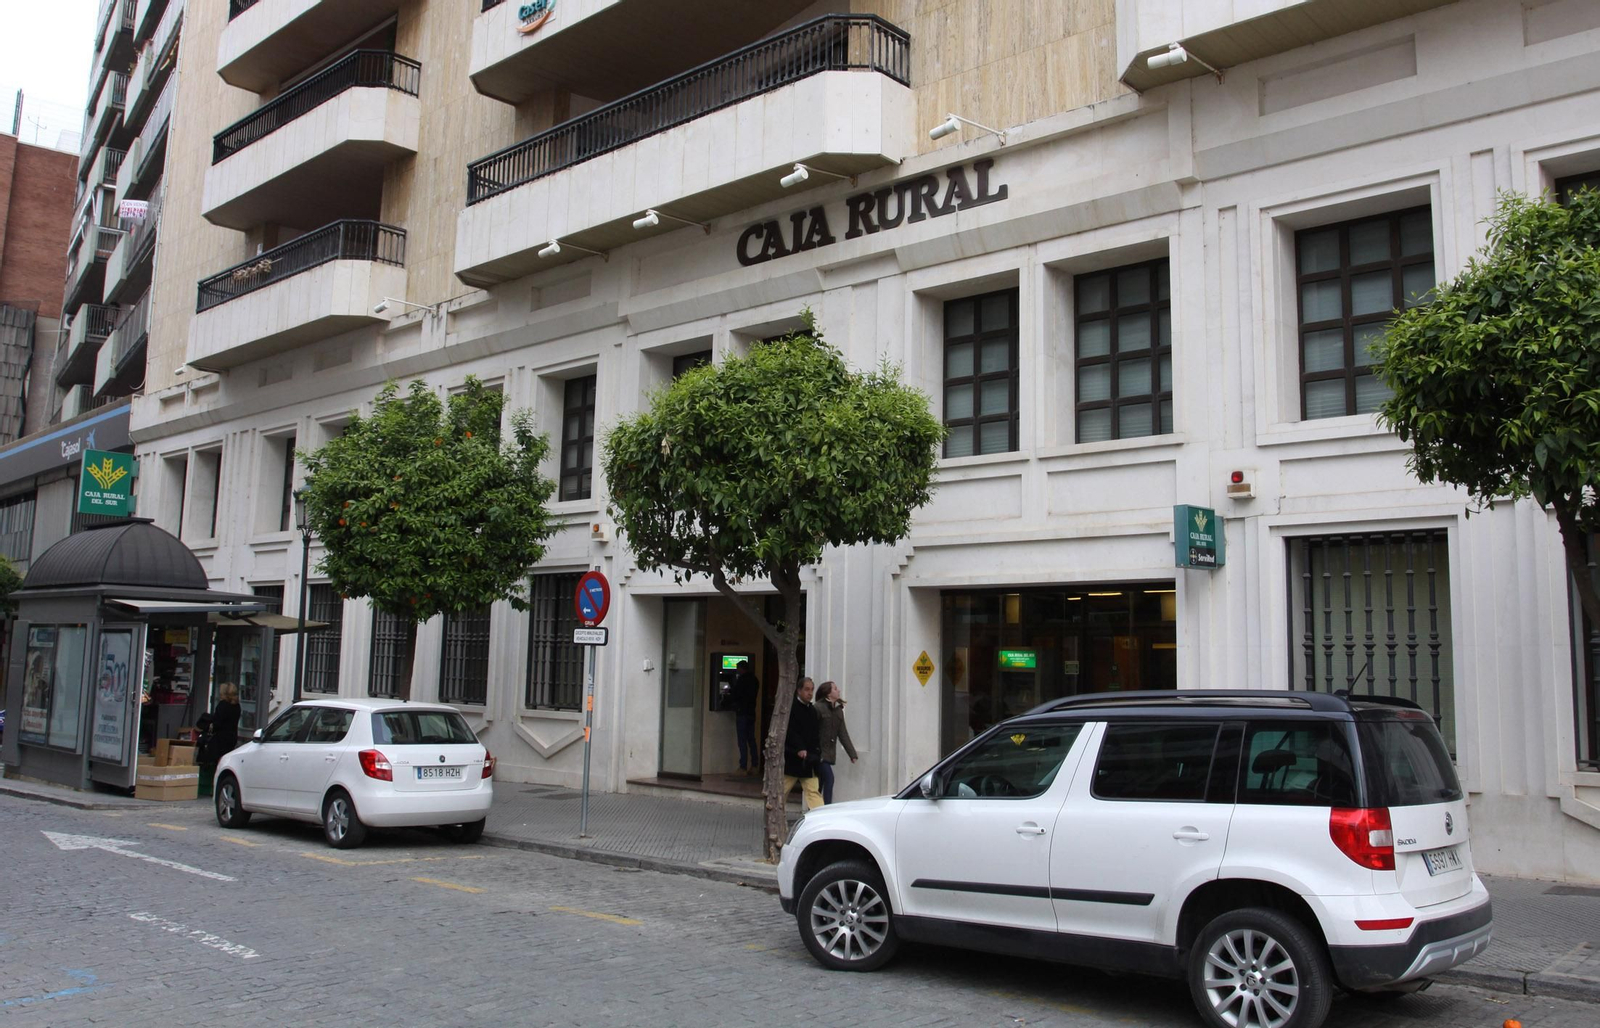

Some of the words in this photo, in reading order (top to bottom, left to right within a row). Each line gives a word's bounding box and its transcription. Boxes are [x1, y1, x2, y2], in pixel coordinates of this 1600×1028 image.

[736, 204, 836, 266] CAJA
[845, 158, 1008, 240] RURAL
[61, 437, 81, 460] Cajasol
[103, 492, 125, 500] RURAL
[423, 768, 443, 777] 8518
[445, 768, 460, 777] HZH
